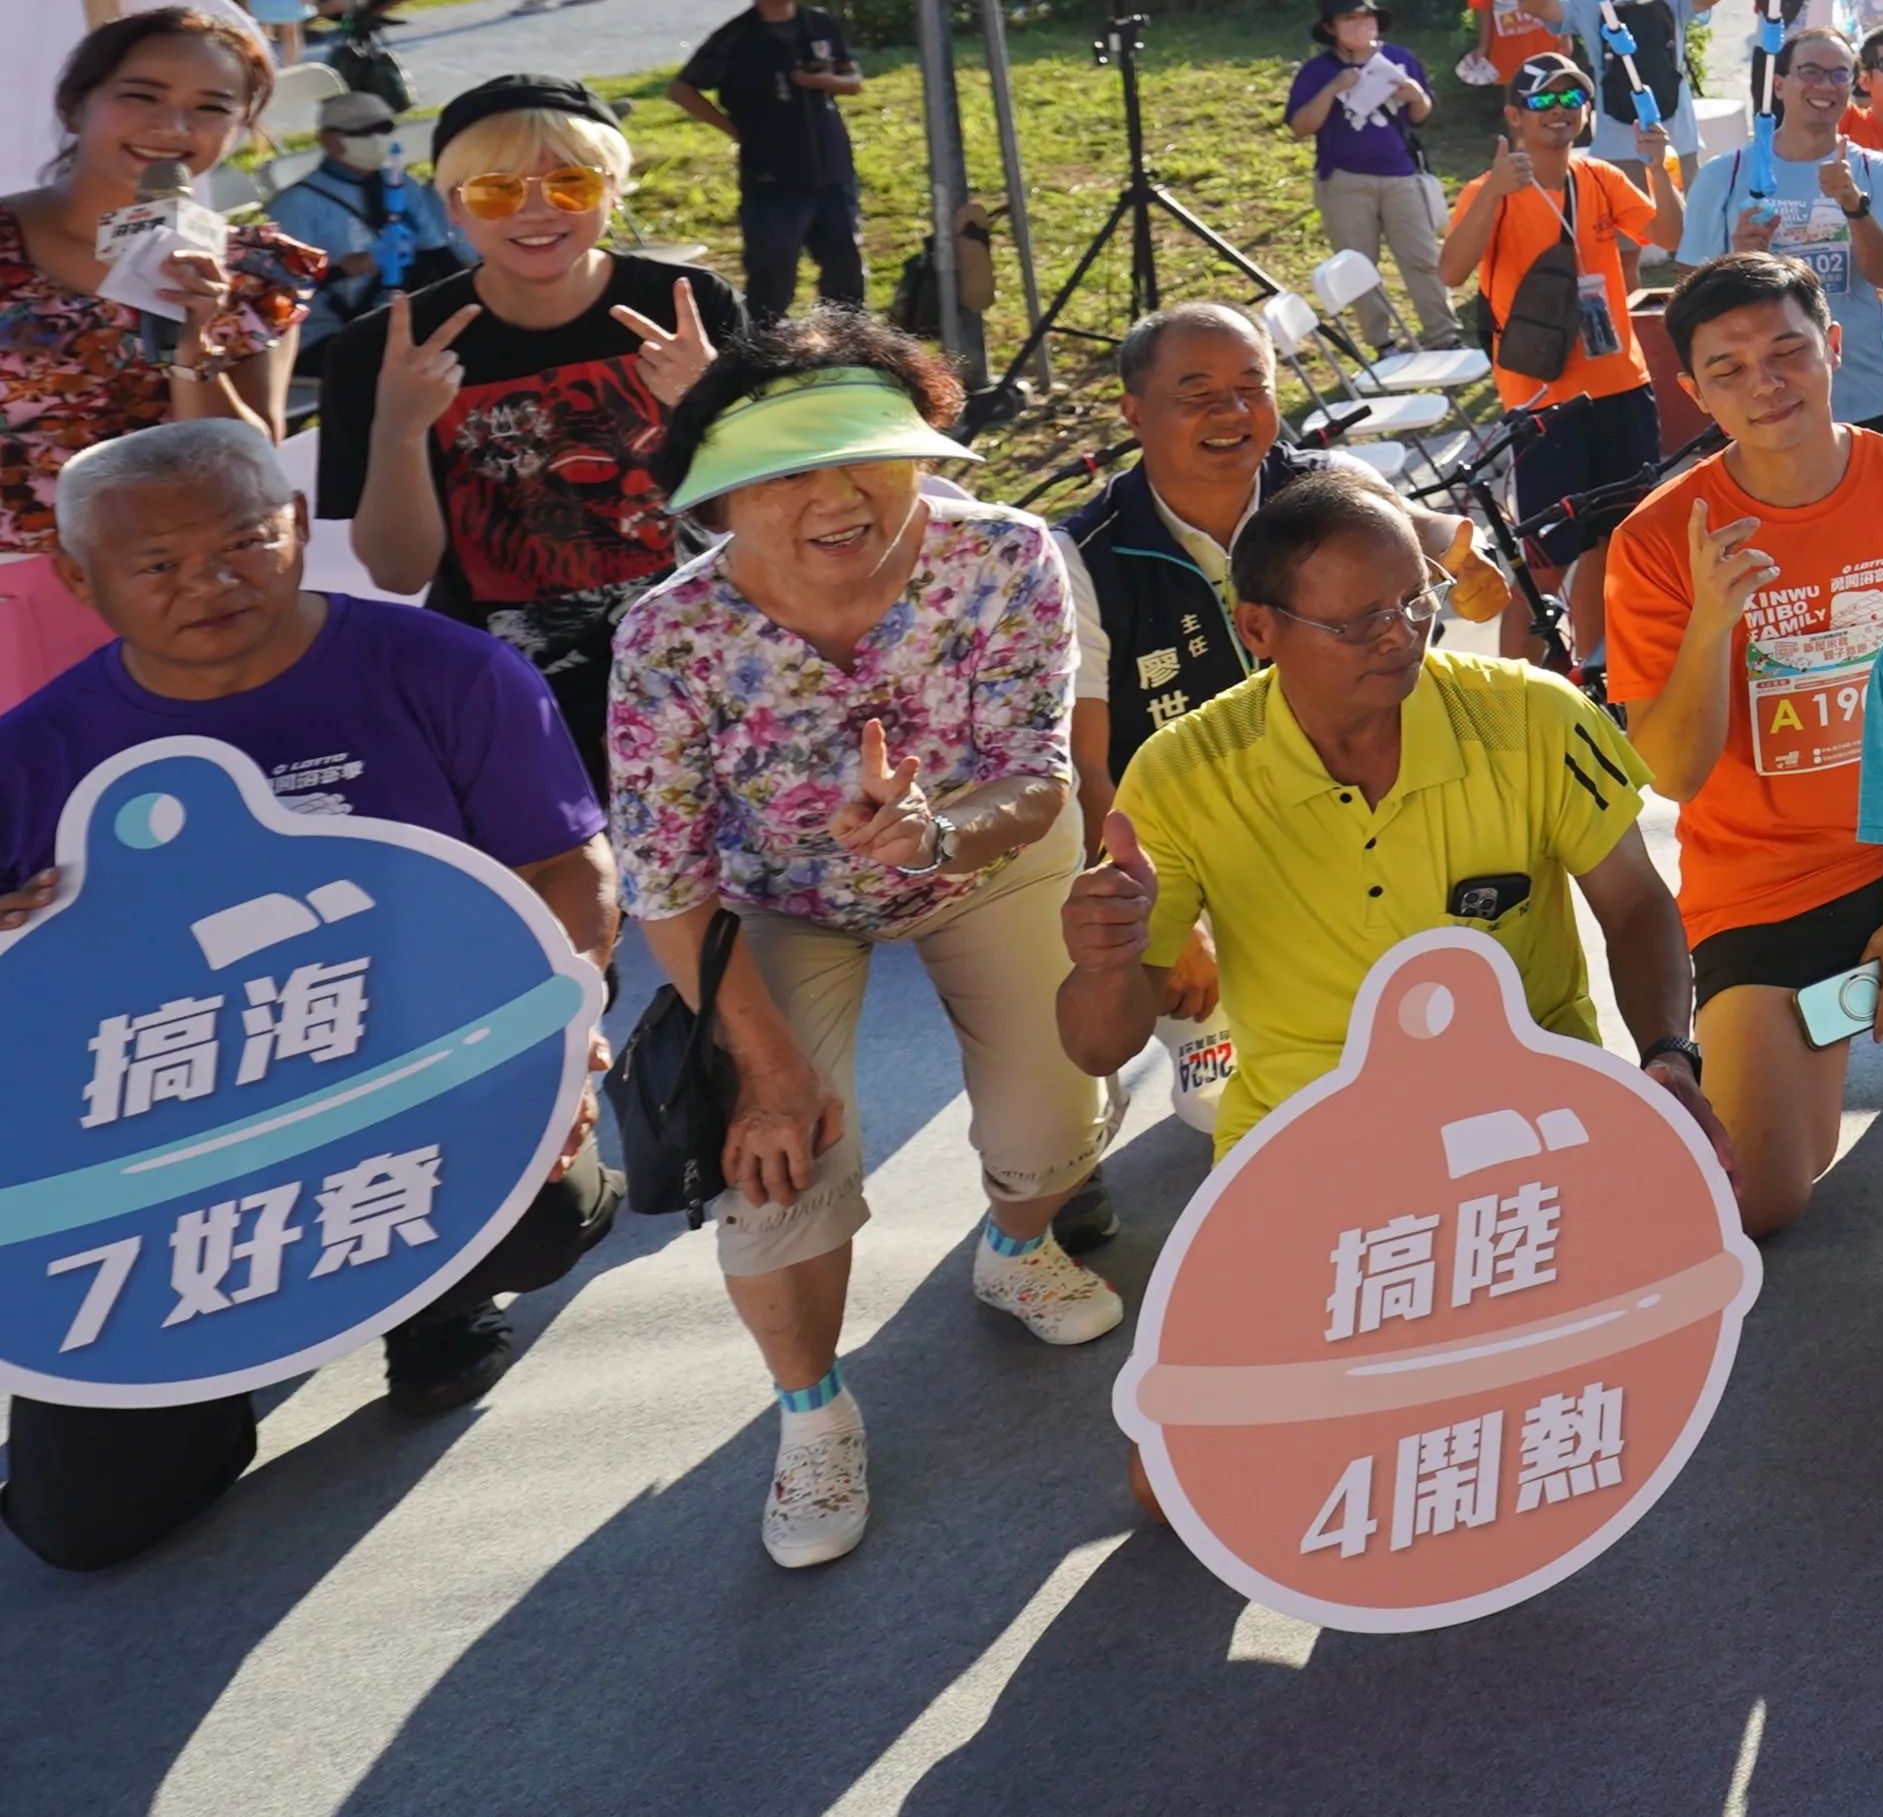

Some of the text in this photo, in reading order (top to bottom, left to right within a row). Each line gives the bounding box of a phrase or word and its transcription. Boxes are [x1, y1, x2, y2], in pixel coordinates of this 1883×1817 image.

[1181, 613, 1209, 659] 主任
[1746, 600, 1809, 629] MIBO
[1770, 699, 1803, 734] A
[80, 956, 374, 1129] 搞海
[1321, 1181, 1562, 1345] 搞陸
[1299, 1381, 1628, 1563] 4鬧熱
